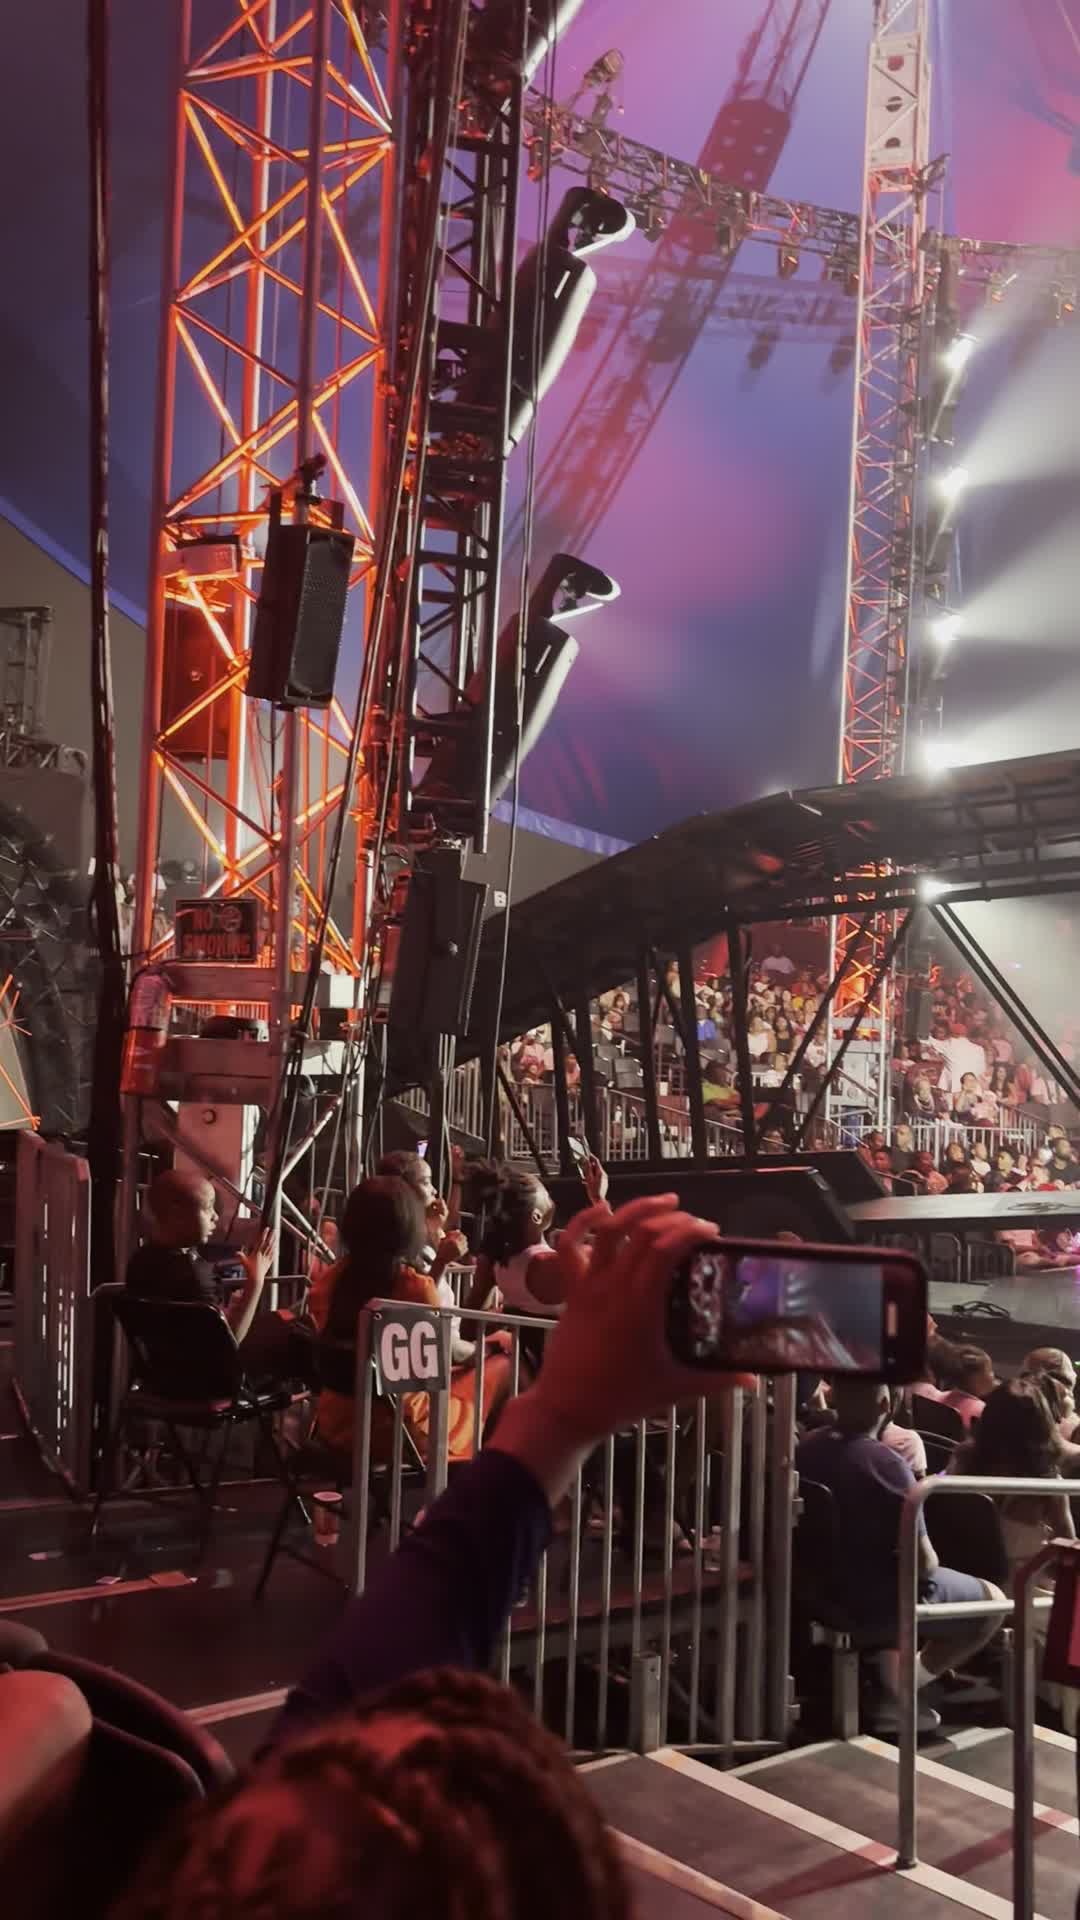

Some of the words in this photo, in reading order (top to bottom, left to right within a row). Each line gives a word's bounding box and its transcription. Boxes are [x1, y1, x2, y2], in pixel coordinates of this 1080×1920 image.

[494, 890, 507, 908] B
[192, 908, 213, 930] NO
[183, 933, 250, 956] SMOKING
[381, 1321, 439, 1381] GG
